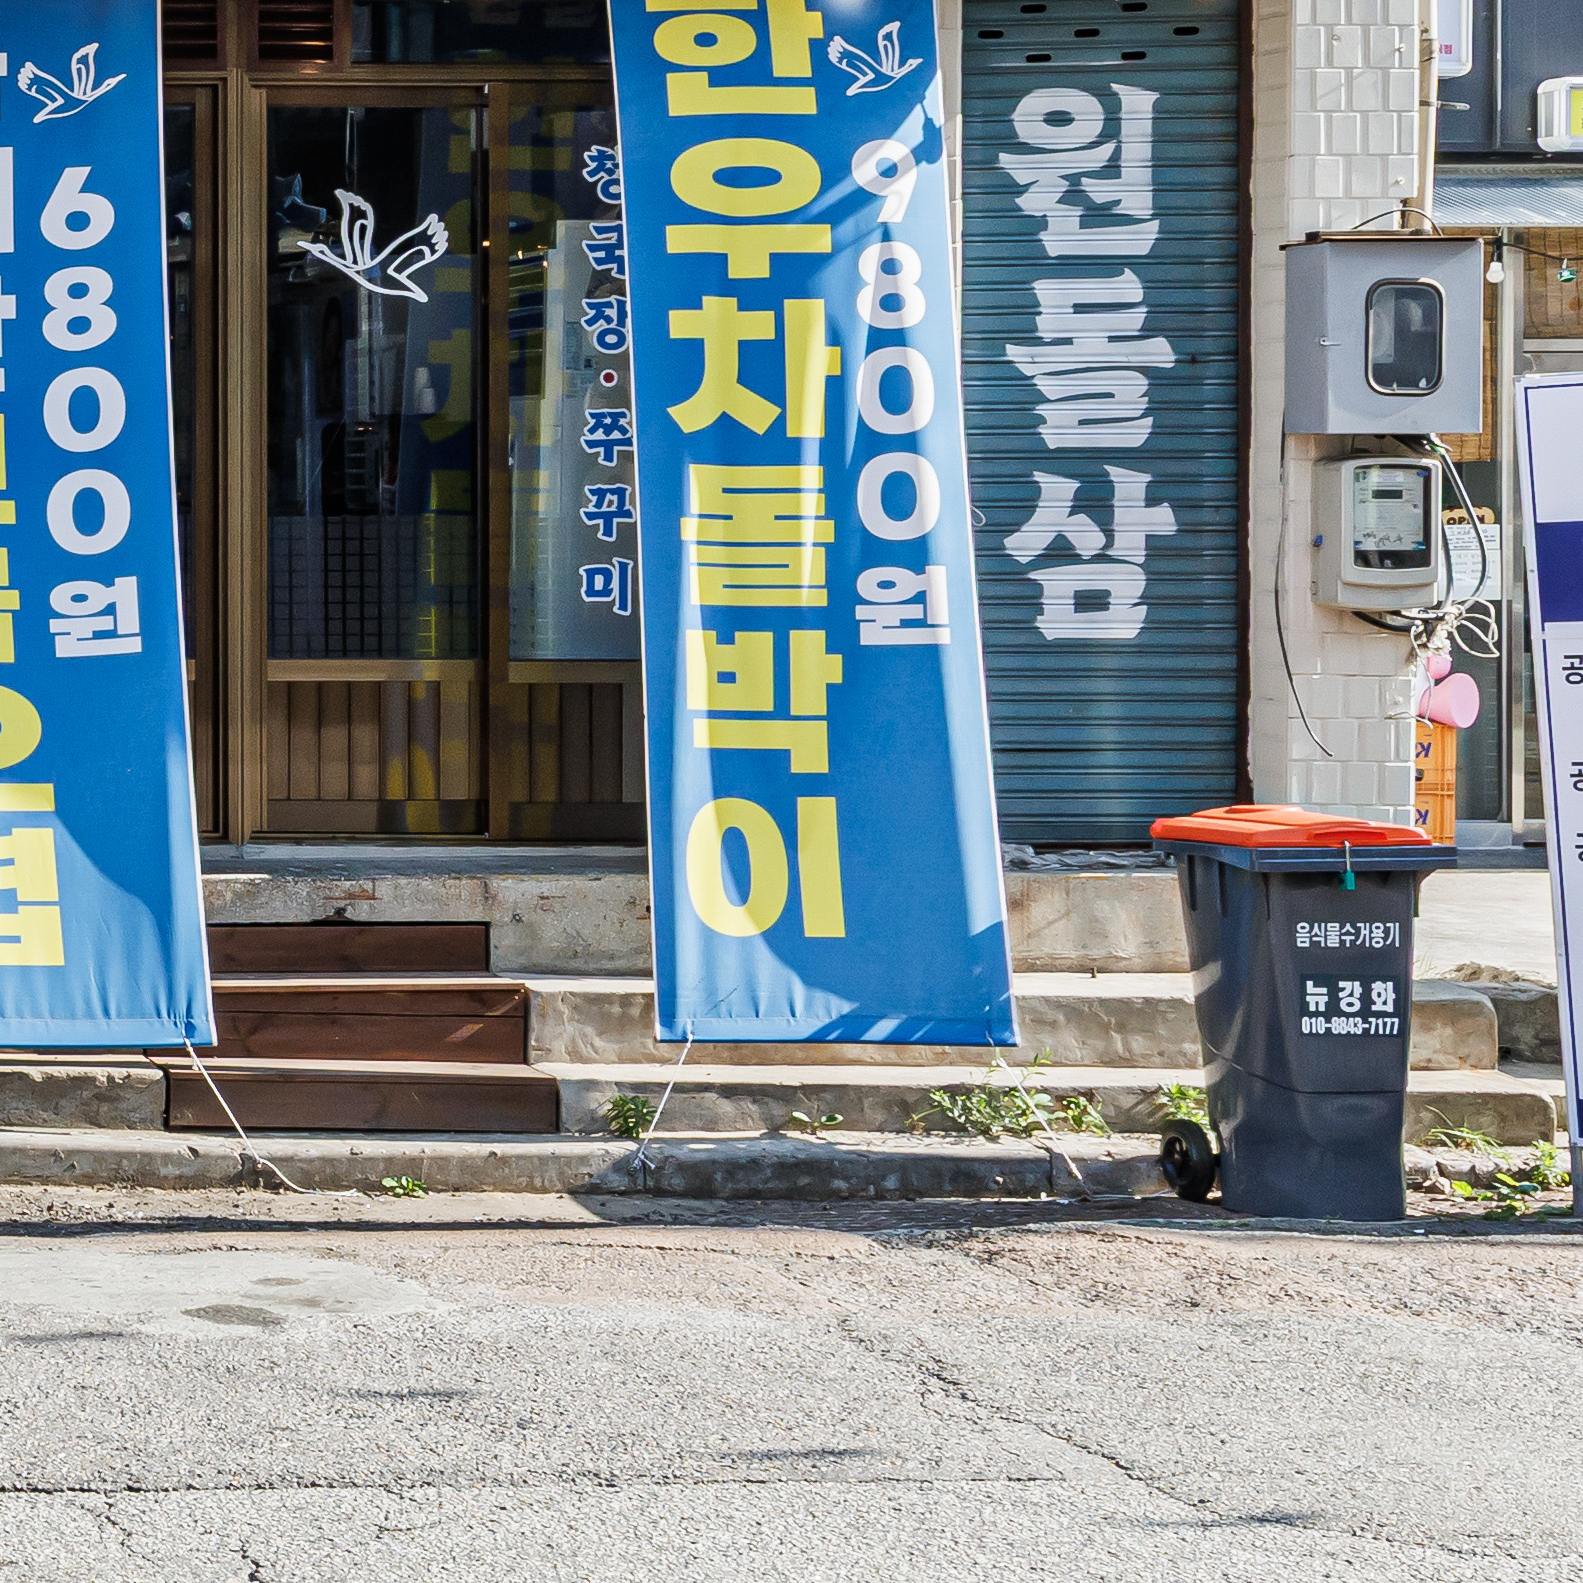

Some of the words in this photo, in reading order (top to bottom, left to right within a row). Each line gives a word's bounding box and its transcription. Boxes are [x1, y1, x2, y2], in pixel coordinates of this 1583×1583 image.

[38, 166, 142, 659] 6800원
[850, 139, 952, 646] 9800원
[998, 83, 1179, 642] 원돌삼
[1296, 922, 1400, 948] 음식물수거용기
